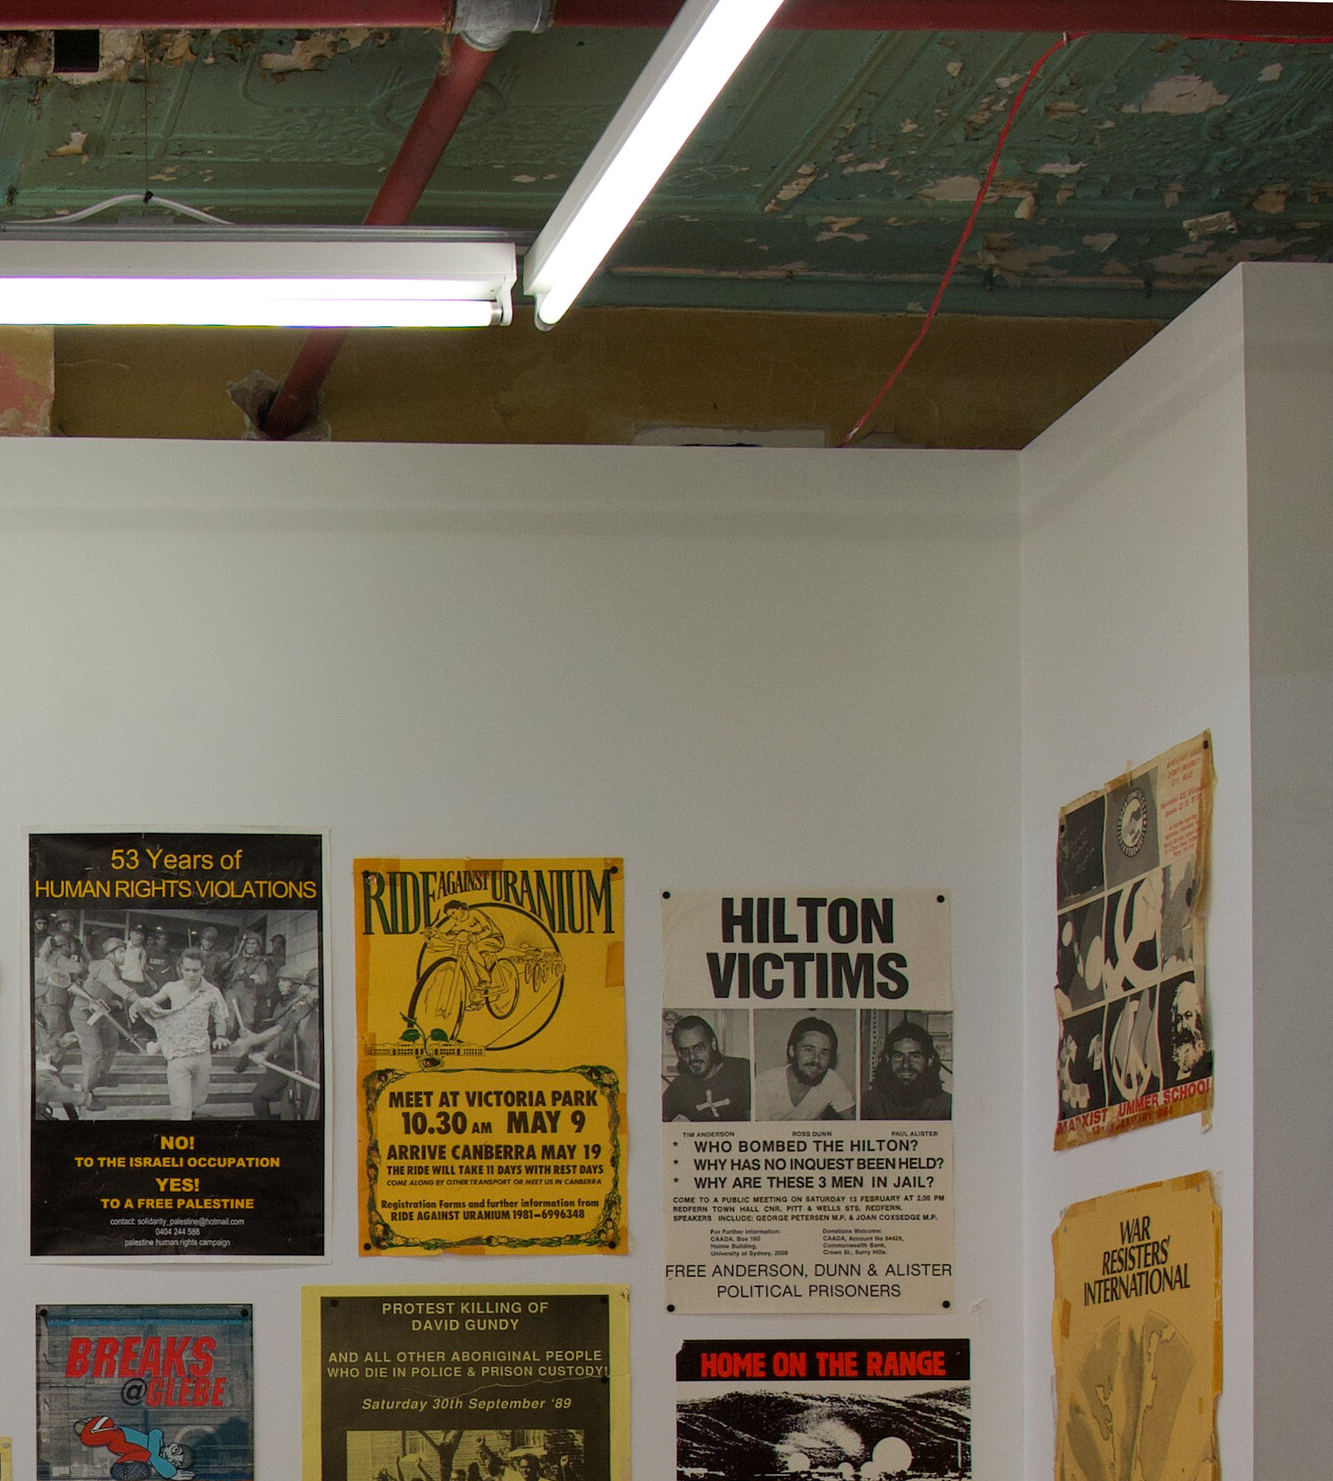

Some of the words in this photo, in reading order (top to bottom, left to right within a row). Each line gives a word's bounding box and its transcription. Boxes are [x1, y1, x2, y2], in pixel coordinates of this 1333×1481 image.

[111, 849, 139, 870] 53
[146, 849, 213, 870] Years
[220, 849, 243, 870] of
[35, 880, 110, 898] HUMAN
[116, 880, 191, 898] RIGHTS
[196, 880, 317, 898] VIOLATIONS
[362, 871, 437, 935] RIDE
[437, 871, 489, 900] AGAINST
[491, 869, 615, 934] URANIUM
[721, 898, 894, 944] HILTON
[706, 952, 909, 999] VICTIMS
[160, 1136, 194, 1150] NO!
[694, 1141, 732, 1152] WHO
[739, 1141, 807, 1152] BOMBED
[813, 1140, 843, 1152] THE
[850, 1140, 918, 1152] HILTON?
[155, 1178, 199, 1192] YES!
[1120, 1216, 1150, 1245] WAR
[1102, 1235, 1170, 1276] RESISTERS'
[665, 1265, 706, 1277] FREE
[712, 1264, 807, 1278] ANDERSON,
[814, 1264, 861, 1276] DUNN
[867, 1264, 877, 1276] &
[885, 1264, 952, 1276] ALISTER
[717, 1286, 802, 1298] POLITICAL
[809, 1284, 901, 1297] PRISONERS
[1084, 1263, 1190, 1306] INTERNATIONAL
[382, 1303, 455, 1314] PROTEST
[460, 1302, 522, 1314] KILLING
[528, 1302, 548, 1314] OF
[412, 1319, 459, 1331] DAVID
[465, 1319, 519, 1331] GUNDY
[65, 1336, 216, 1379] BREAKS
[701, 1352, 766, 1378] HOME
[773, 1352, 807, 1377] ON
[816, 1352, 858, 1376] THE
[867, 1351, 946, 1376] RANGE
